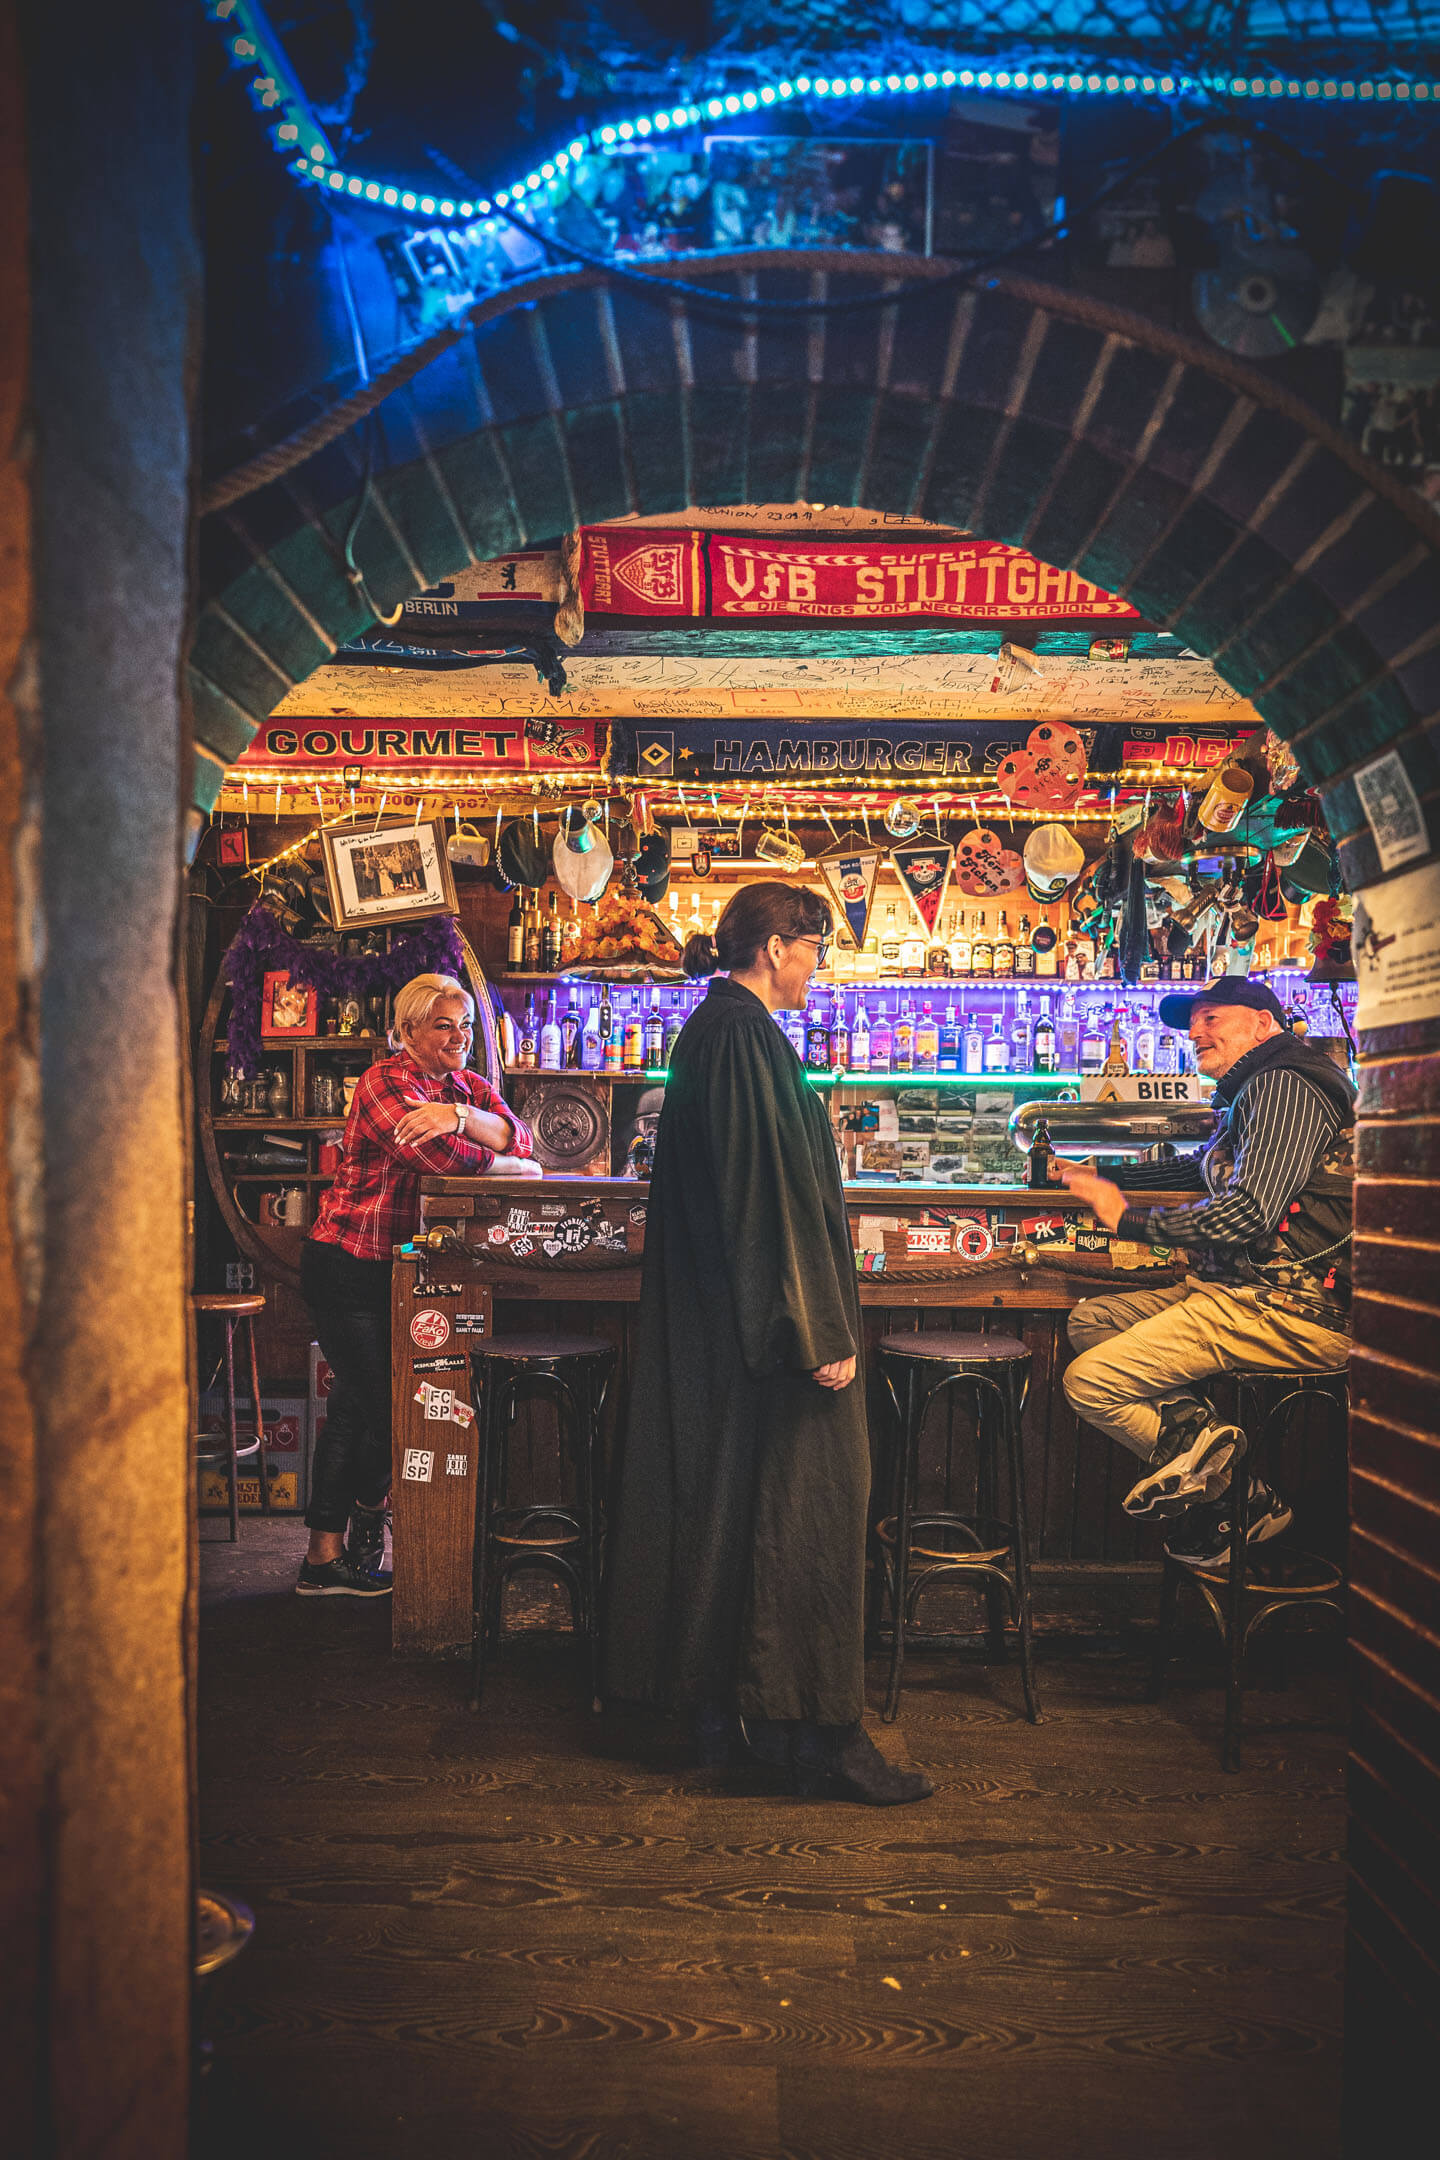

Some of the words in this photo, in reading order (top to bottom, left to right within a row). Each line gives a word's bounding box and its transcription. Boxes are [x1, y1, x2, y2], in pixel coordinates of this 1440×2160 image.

[880, 550, 976, 566] SUPER
[724, 555, 817, 601] VfB
[405, 602, 458, 616] BERLIN
[757, 602, 788, 611] DIE
[799, 603, 855, 615] KINGS
[867, 603, 910, 614] VOM
[921, 601, 1094, 616] NECKAR-STADION
[266, 728, 518, 758] GOURMET
[713, 738, 973, 773] HAMBURGER
[983, 741, 1023, 774] S
[442, 796, 488, 809] 2007
[1138, 1082, 1189, 1100] BIER
[509, 1234, 531, 1251] FCK
[513, 1241, 533, 1256] HSV
[429, 1390, 451, 1404] FC
[428, 1405, 450, 1418] SP
[408, 1450, 430, 1465] FC
[446, 1460, 468, 1469] 1910
[407, 1465, 428, 1479] SP
